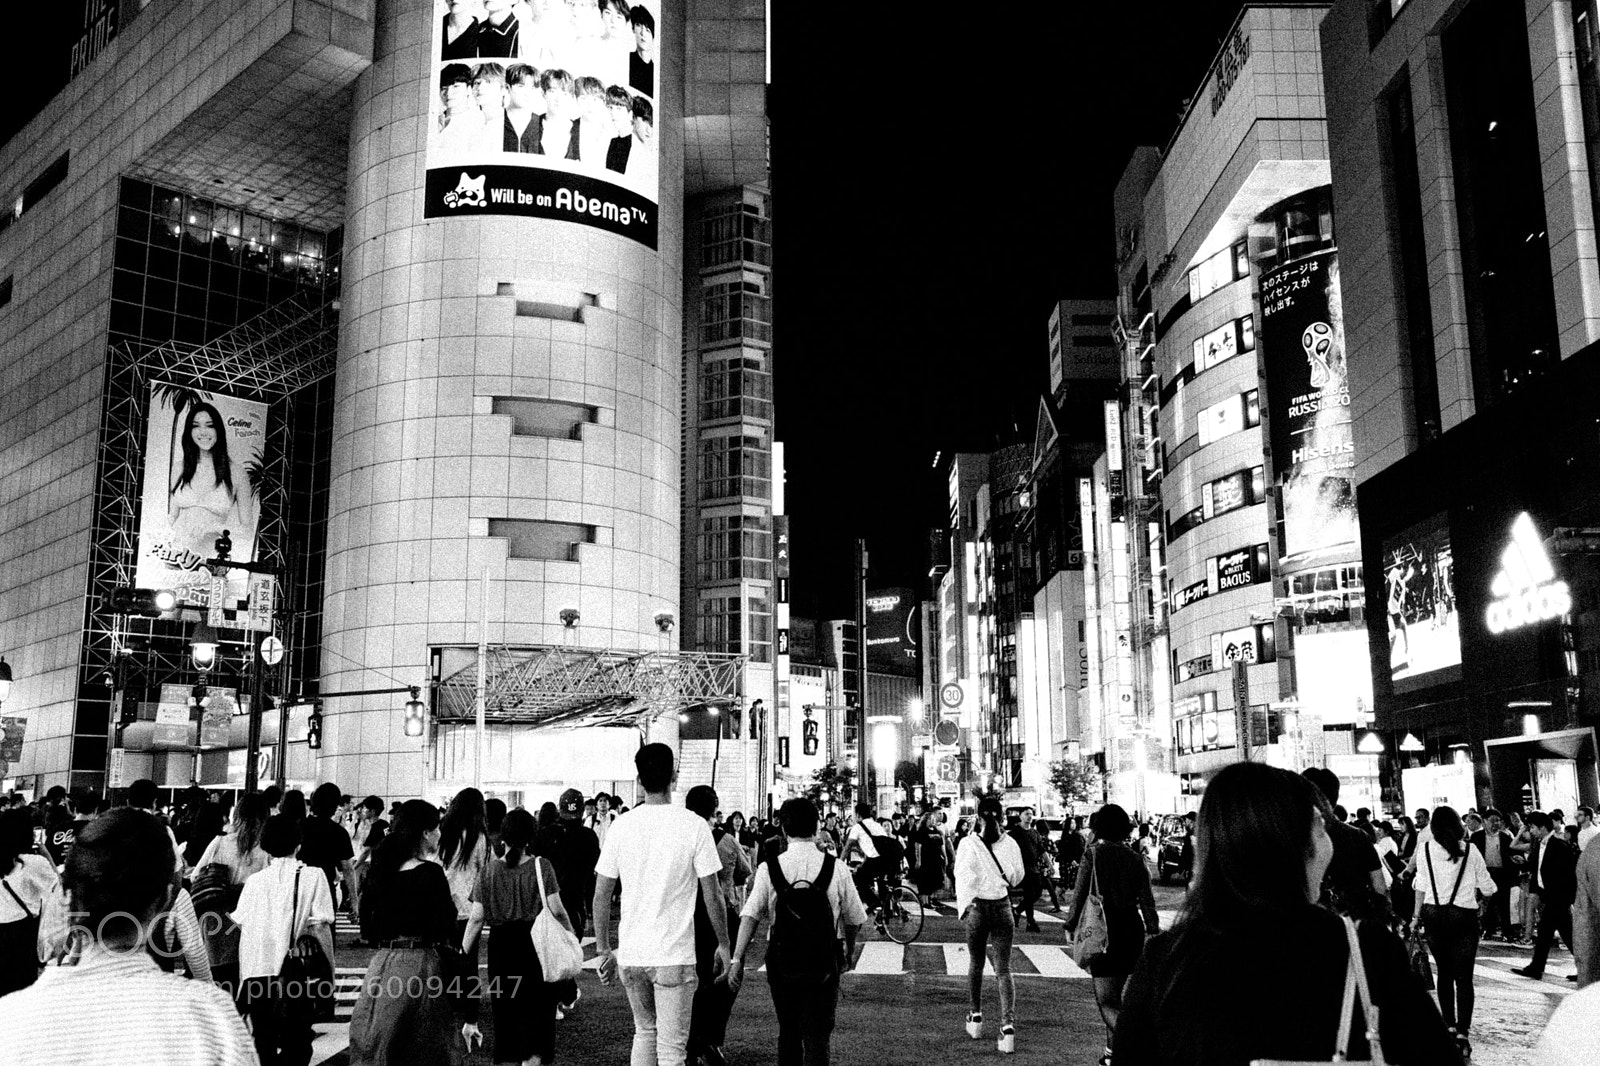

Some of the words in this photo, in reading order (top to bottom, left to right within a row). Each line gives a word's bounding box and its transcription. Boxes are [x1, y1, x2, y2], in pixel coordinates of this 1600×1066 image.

[491, 188, 515, 204] Will
[517, 189, 534, 205] be
[536, 194, 552, 207] on
[1262, 261, 1319, 291] 次のステージは
[1264, 276, 1310, 304] ハイセンスが
[1264, 296, 1295, 317] 映し出す。
[1291, 394, 1309, 406] FIFA
[227, 416, 253, 429] Celine
[1219, 570, 1251, 590] BAGUS
[260, 578, 271, 627] 道玄坂下
[945, 689, 960, 702] 30
[1240, 705, 1248, 730] LOUIS
